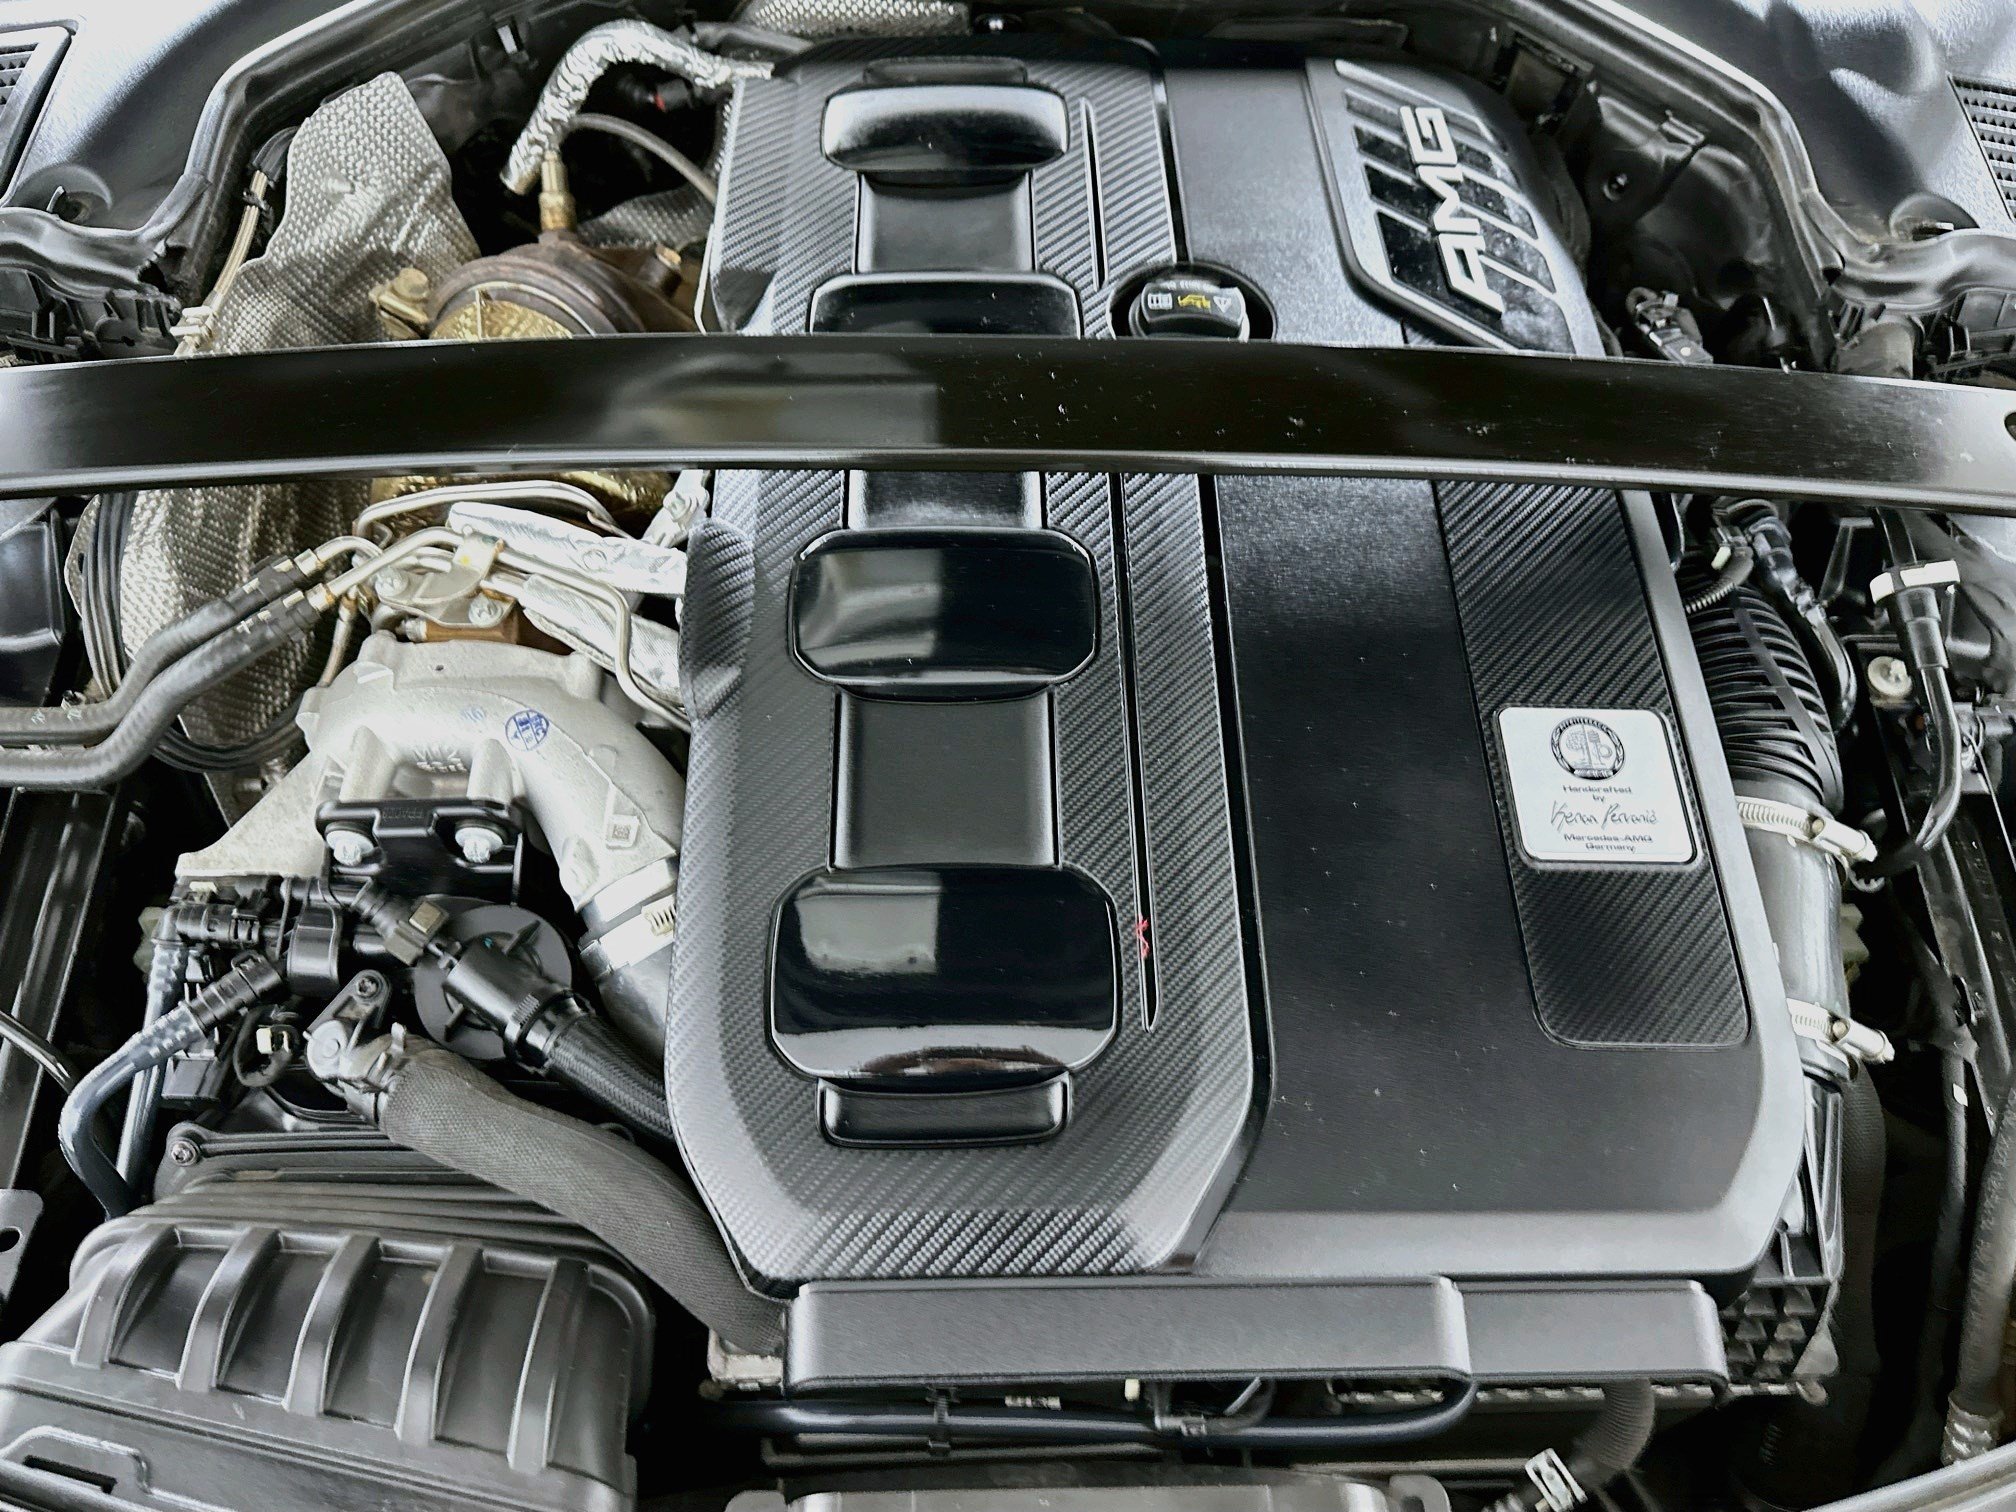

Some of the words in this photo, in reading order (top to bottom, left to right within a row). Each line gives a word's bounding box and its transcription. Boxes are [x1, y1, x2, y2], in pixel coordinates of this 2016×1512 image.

[1400, 105, 1504, 313] AMG
[1562, 784, 1632, 794] Handcrafted
[1592, 794, 1605, 803] by
[1563, 833, 1653, 843] Mercedes-AMG
[1585, 842, 1636, 854] Germany
